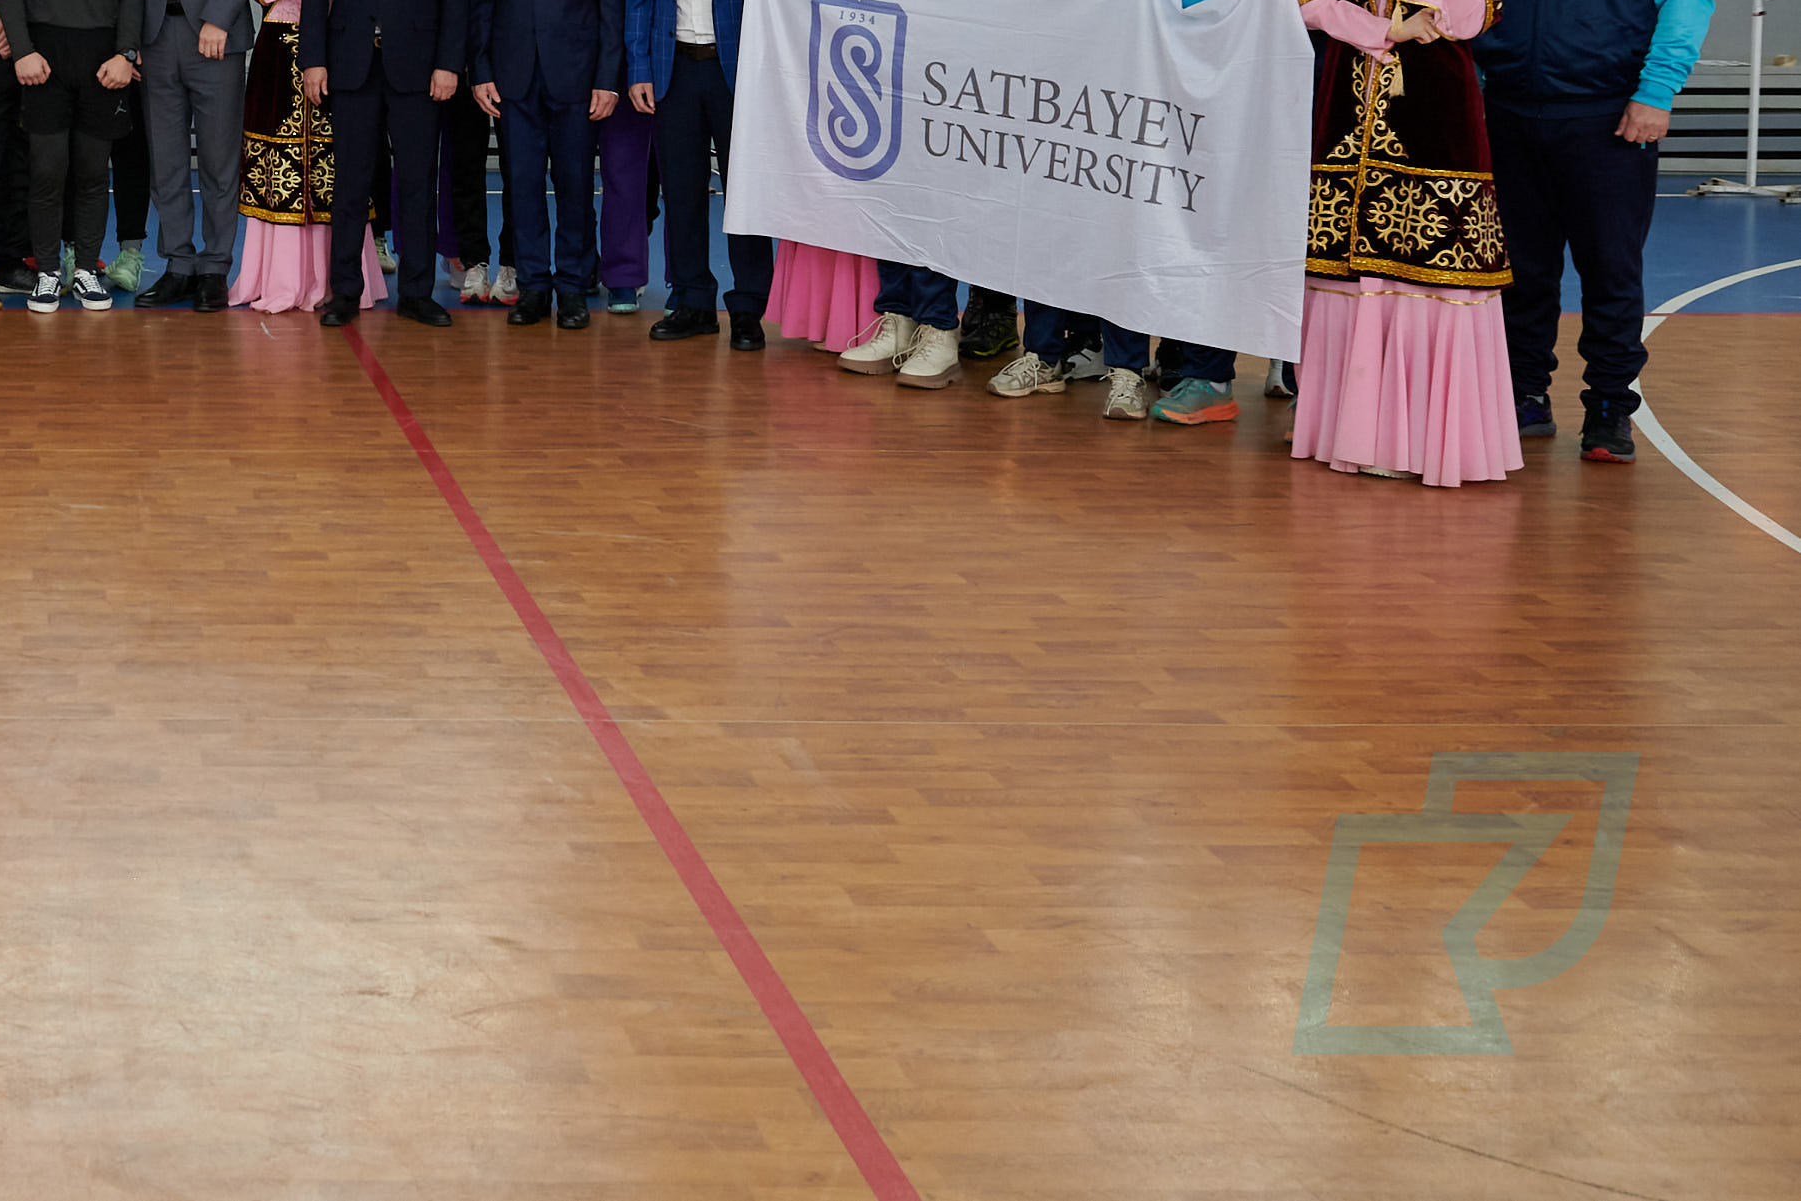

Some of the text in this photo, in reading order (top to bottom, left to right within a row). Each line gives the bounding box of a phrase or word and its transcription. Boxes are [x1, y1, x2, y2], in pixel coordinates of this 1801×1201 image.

[839, 9, 877, 26] 1934
[922, 61, 1206, 156] SATBAYEV
[921, 117, 1206, 213] UNIVERSITY
